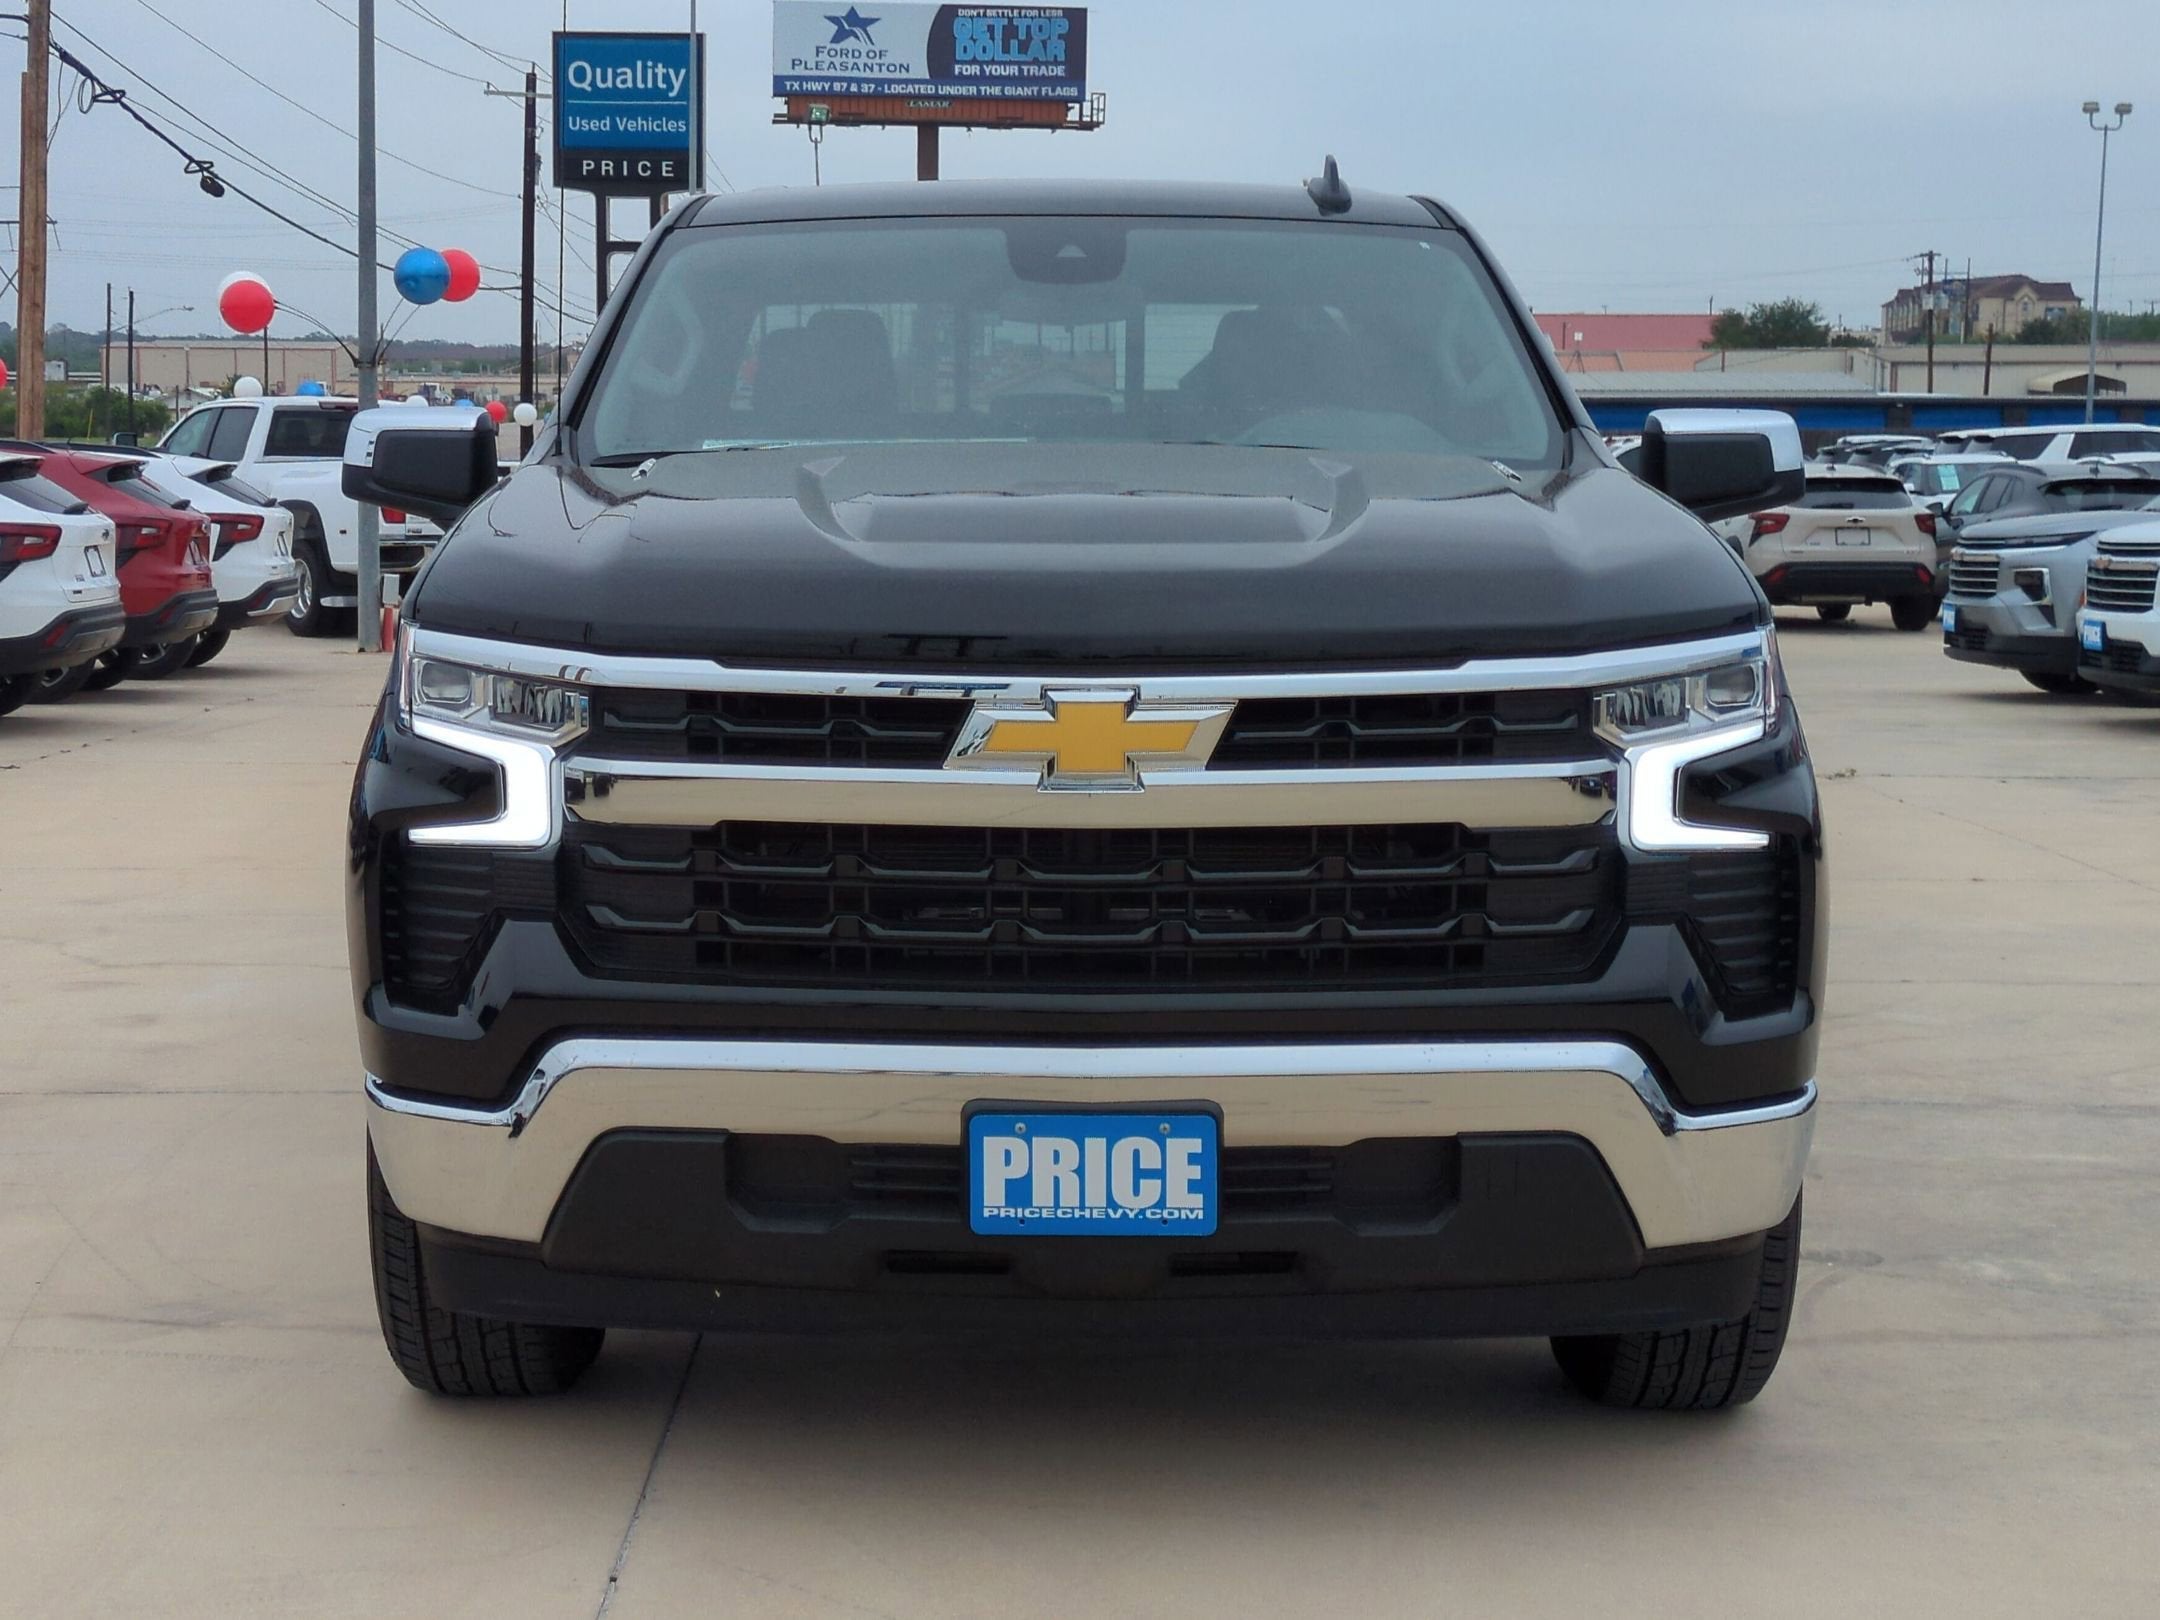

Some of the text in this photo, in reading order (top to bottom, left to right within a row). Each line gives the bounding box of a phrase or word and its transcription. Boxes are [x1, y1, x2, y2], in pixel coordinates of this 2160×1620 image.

[958, 8, 985, 17] DON'T
[1021, 9, 1039, 17] FOR
[1041, 9, 1063, 17] LESS
[953, 17, 1069, 41] GET TOP
[815, 46, 889, 60] FORD OF
[955, 38, 1066, 62] DOLLAR
[791, 58, 910, 74] PLEASANTON
[954, 65, 1066, 77] FOR YOUR TRADE
[567, 60, 687, 98] Quality
[784, 81, 800, 91] TX
[802, 81, 831, 92] HWY
[860, 84, 876, 93] 37
[884, 84, 936, 94] LOCATED
[938, 85, 977, 95] UNDER
[979, 86, 1003, 95] THE
[1004, 86, 1039, 96] GIANT
[1041, 87, 1078, 96] FLAGS
[568, 116, 687, 132] Used Vehicles
[582, 160, 675, 177] PRICE
[983, 1136, 1204, 1209] PRICE
[983, 1207, 1204, 1219] PRICECHEVY.COM
